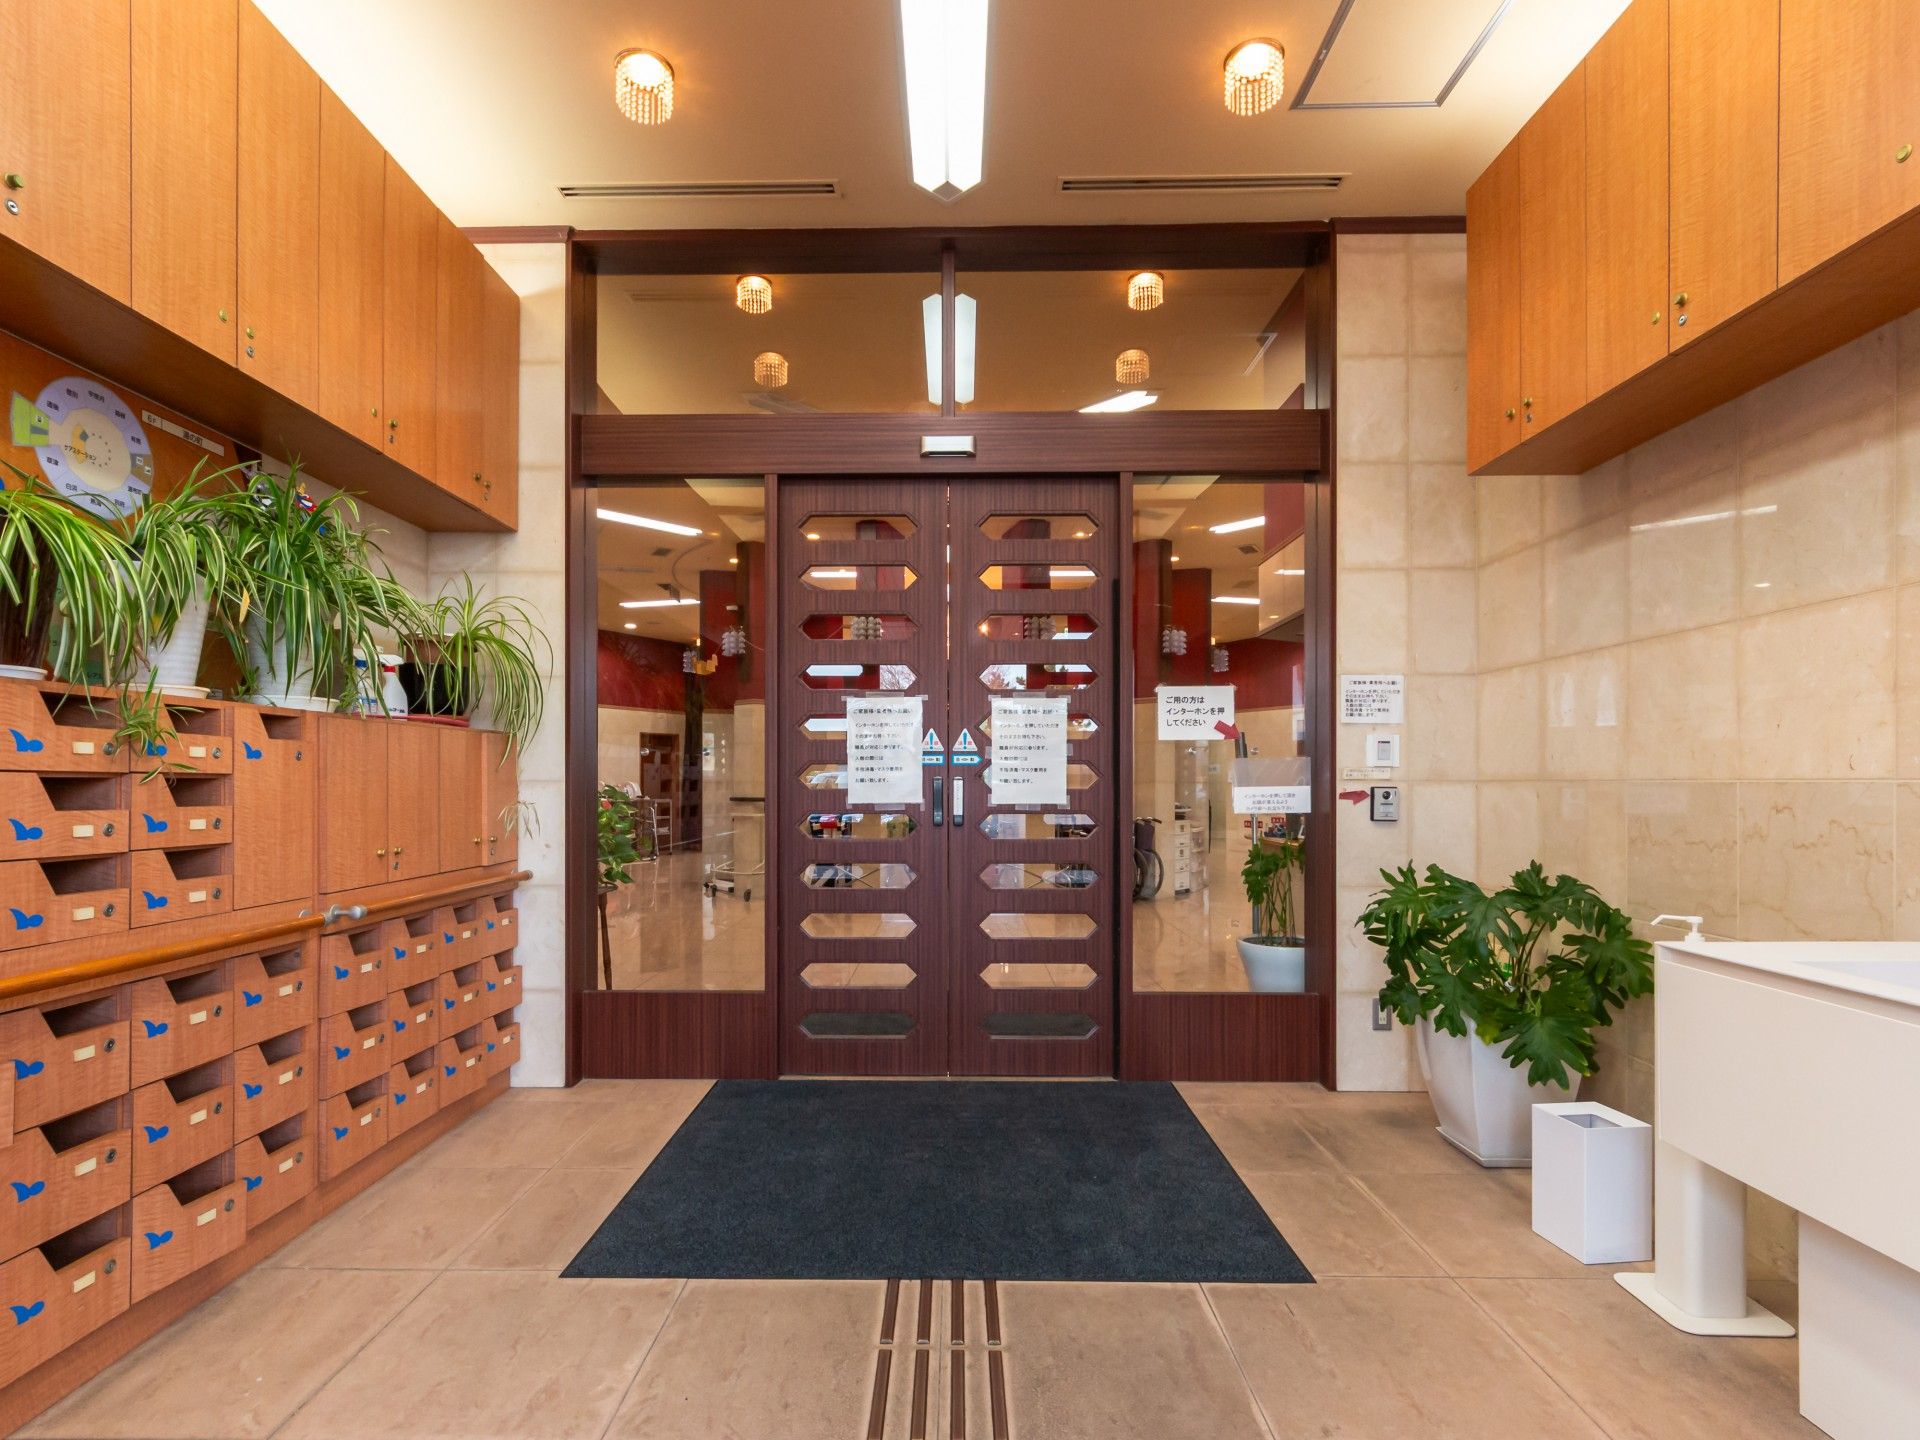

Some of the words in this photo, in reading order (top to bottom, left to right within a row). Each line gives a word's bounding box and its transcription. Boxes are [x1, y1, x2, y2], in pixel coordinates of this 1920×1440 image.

[1165, 696, 1205, 704] ご用の方は
[1166, 707, 1225, 716] インターホンを押
[1166, 719, 1206, 727] してください
